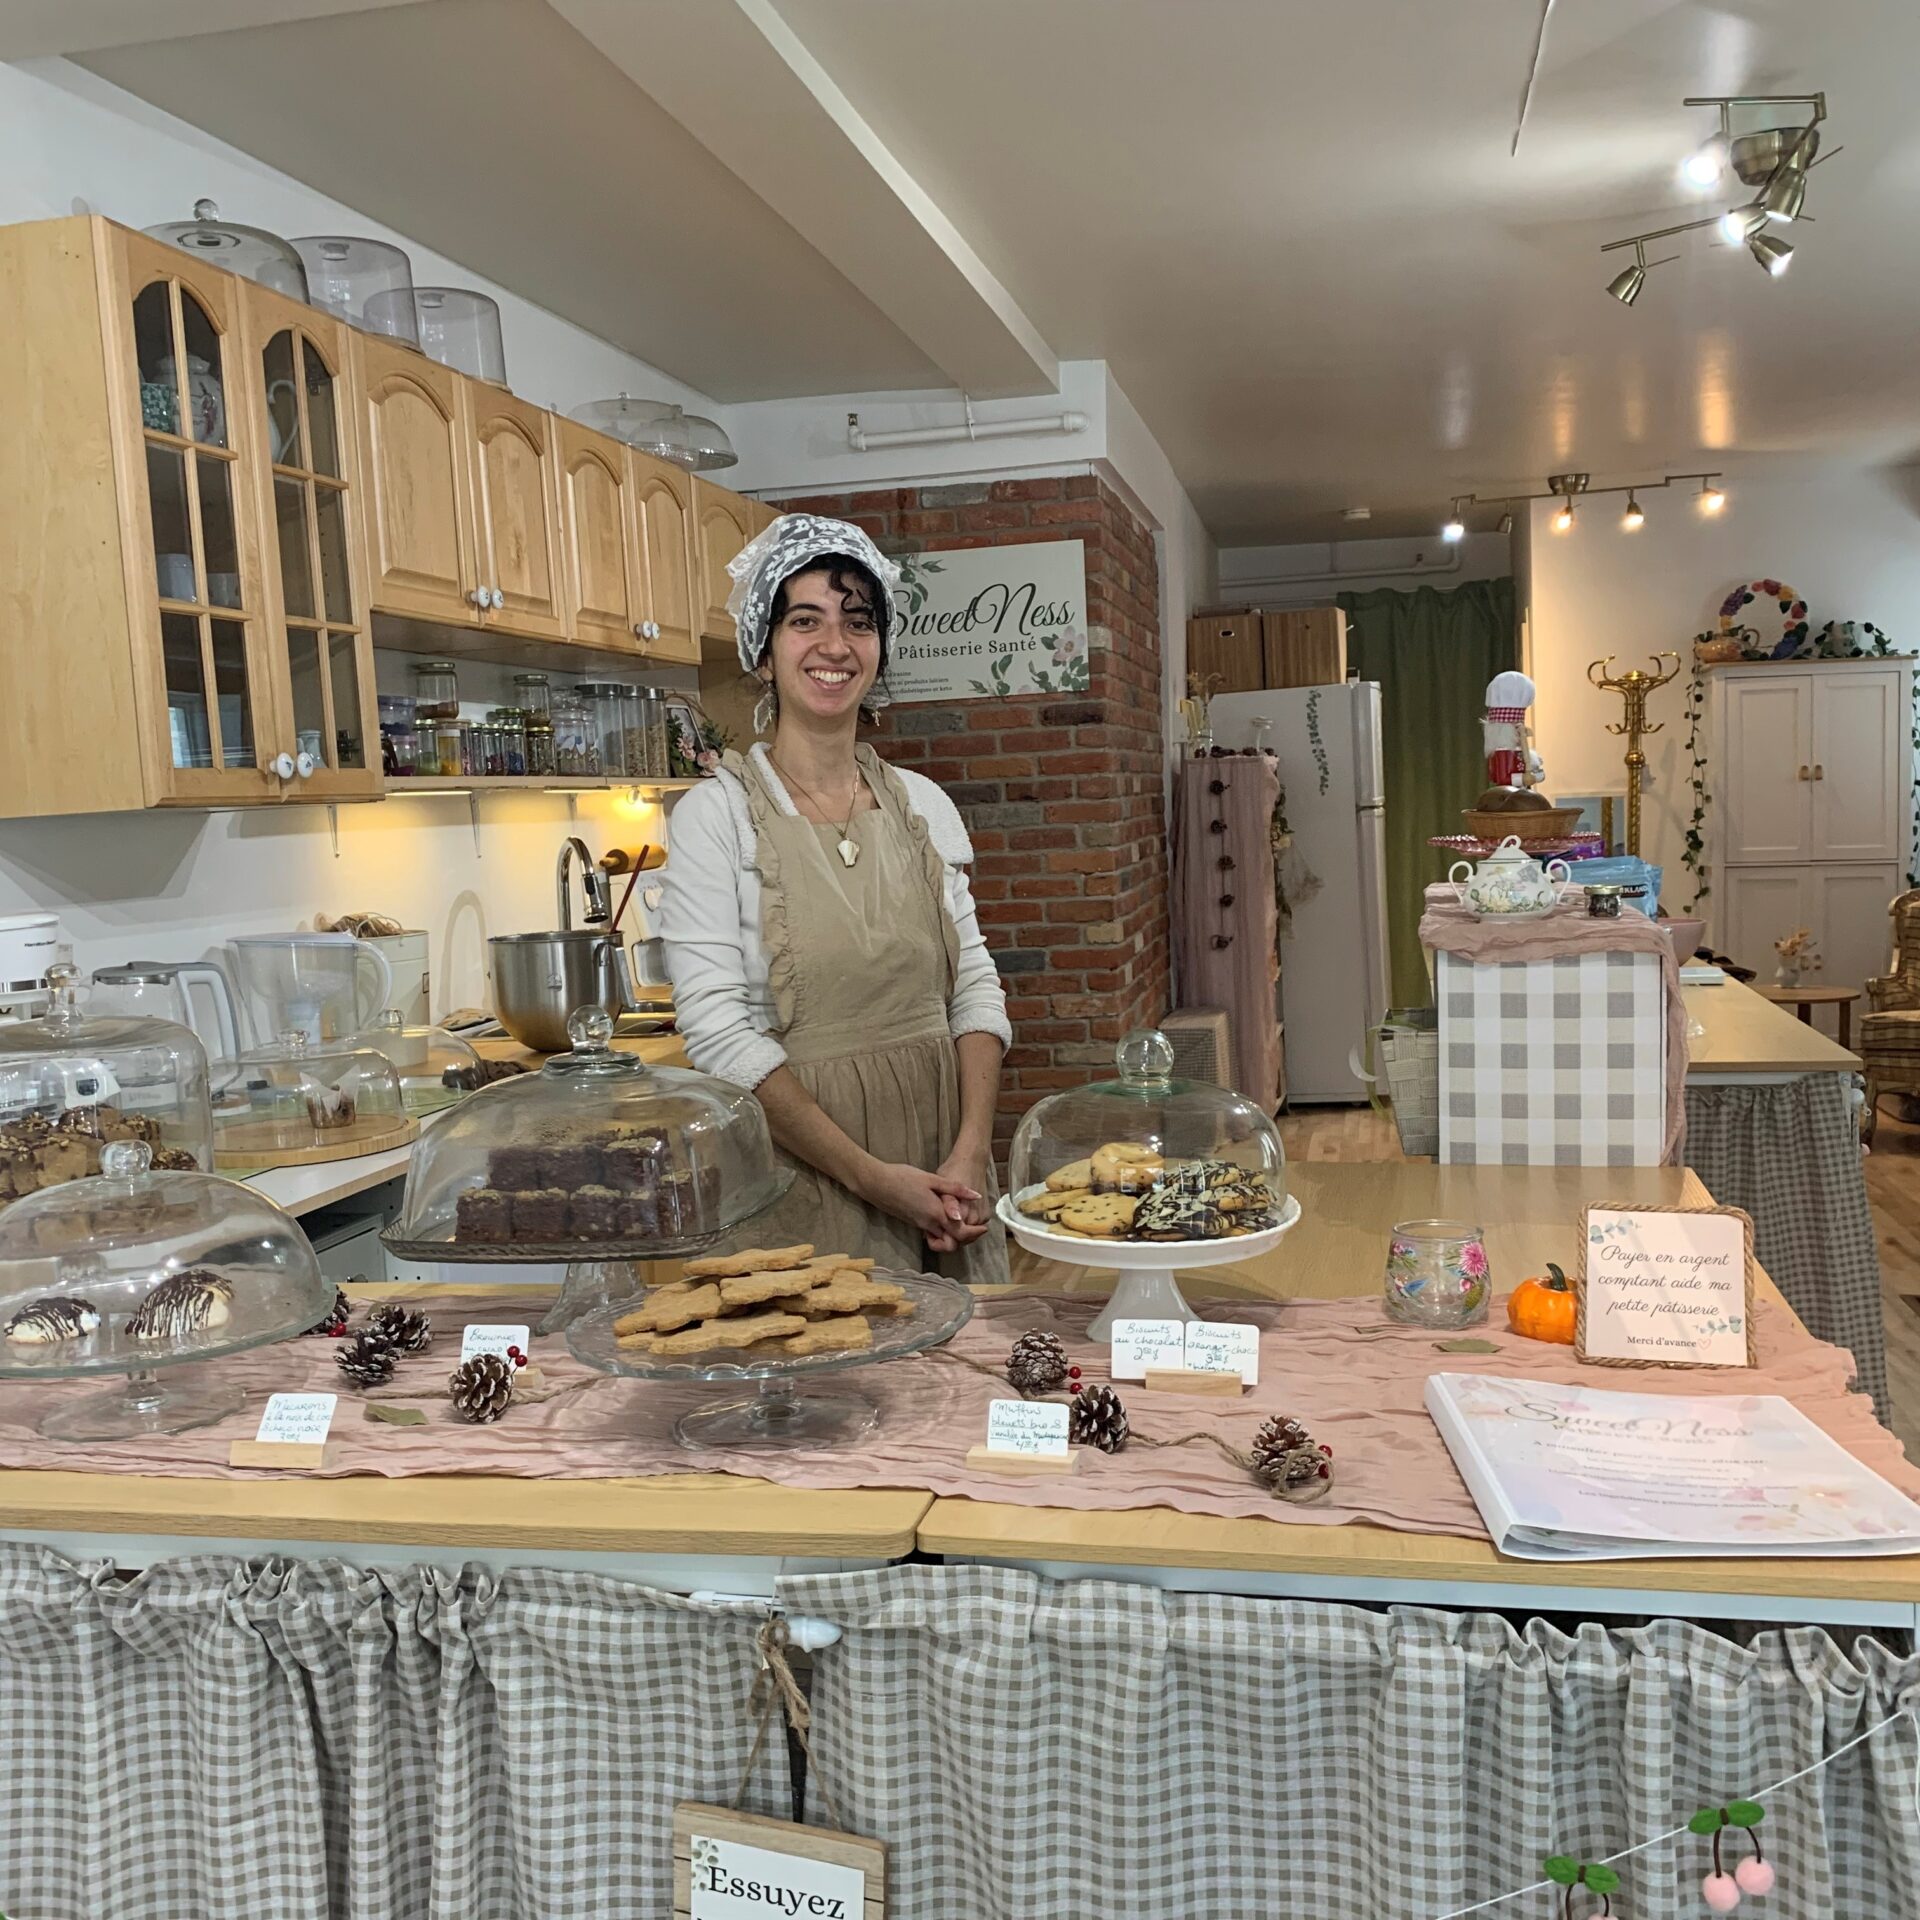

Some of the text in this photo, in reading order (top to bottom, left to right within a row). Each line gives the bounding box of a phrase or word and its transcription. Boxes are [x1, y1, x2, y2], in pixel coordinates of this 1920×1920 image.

[972, 582, 1075, 636] Ness
[898, 636, 1037, 660] Pâtisserie Santé
[1601, 1245, 1729, 1272] Payer en argent
[1598, 1274, 1732, 1291] comptant aide ma
[1606, 1300, 1719, 1317] petite pâtisserie
[469, 1328, 516, 1343] Brownies
[1125, 1321, 1170, 1334] Biscuits
[1195, 1325, 1241, 1339] Biscuits
[1135, 1334, 1184, 1347] chocolat
[1627, 1336, 1697, 1347] Merci d'avance
[995, 1402, 1041, 1417] Muffins
[708, 1865, 845, 1920] Essuyez
